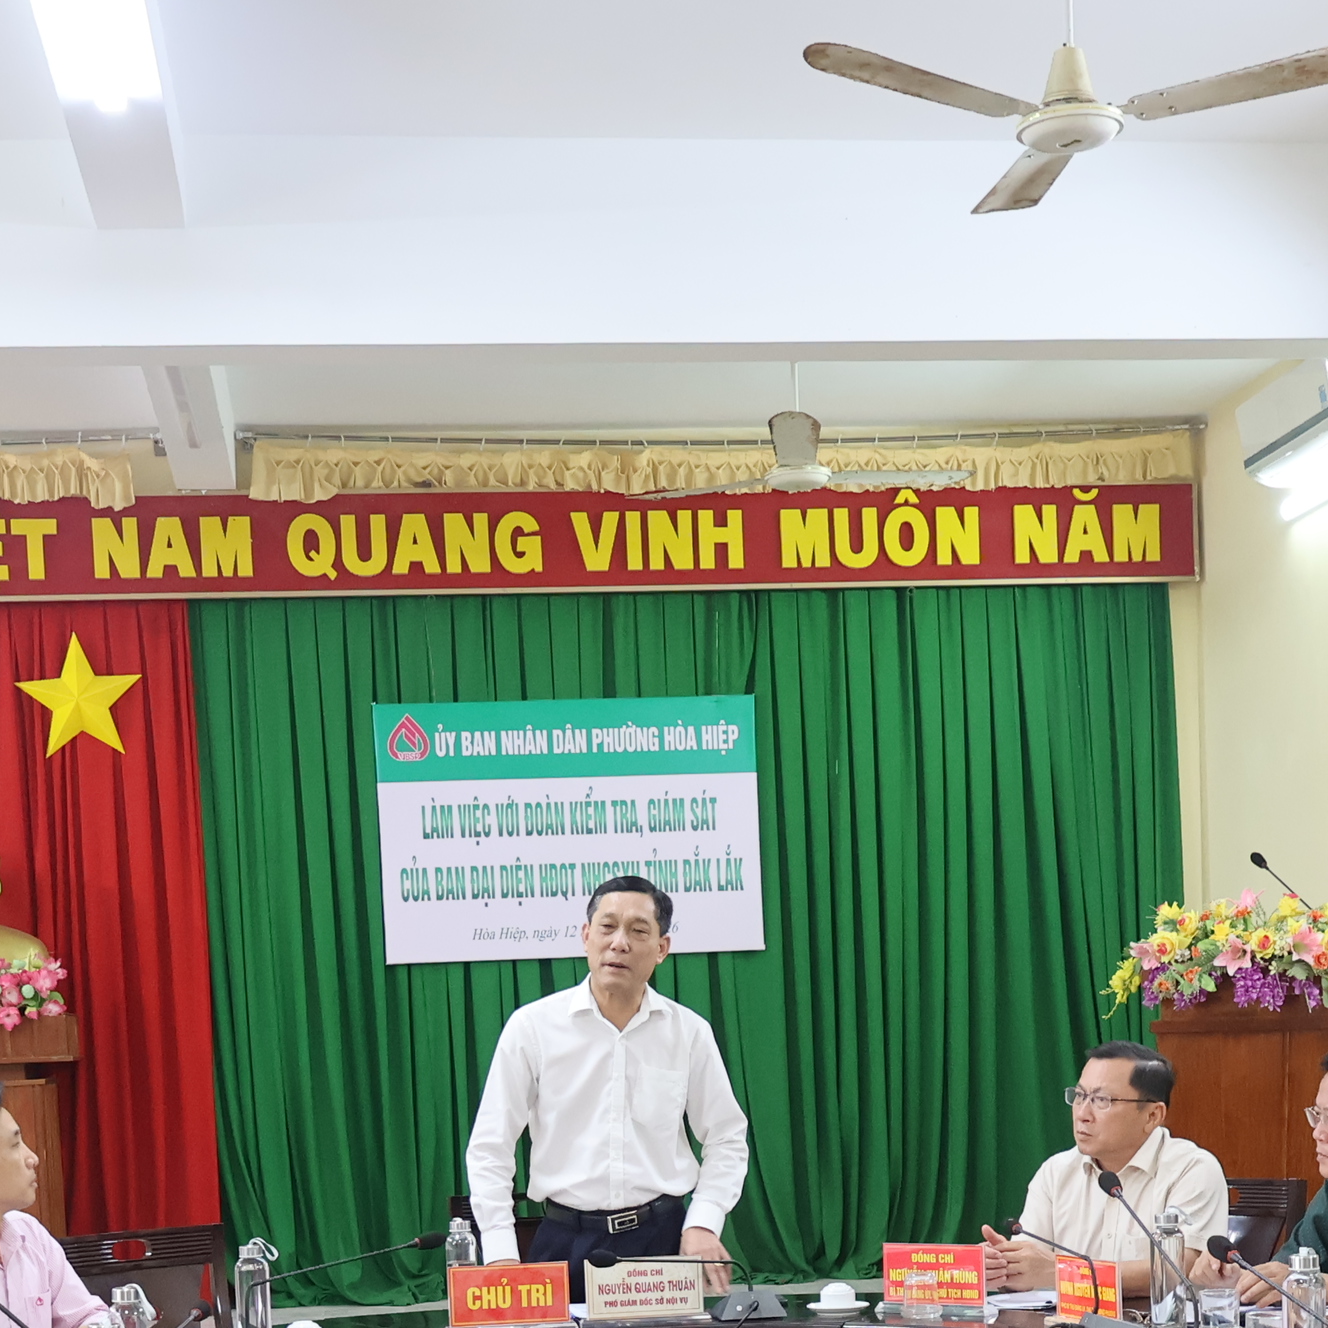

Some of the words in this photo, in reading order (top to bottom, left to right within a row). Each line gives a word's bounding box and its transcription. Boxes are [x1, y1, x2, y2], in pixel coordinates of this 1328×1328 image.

[91, 515, 254, 580] NAM
[286, 510, 544, 579] QUANG
[570, 508, 745, 573] VINH
[779, 490, 982, 569] MUÔN
[1014, 488, 1162, 565] NĂM
[435, 724, 456, 757] ỦY
[461, 731, 497, 756] BAN
[501, 725, 548, 755] NHÂN
[553, 724, 587, 754] DÂN
[592, 722, 659, 752] PHƯỜNG
[664, 720, 698, 751] HÒA
[702, 720, 740, 756] HIỆP
[421, 798, 454, 839] LÀM
[458, 796, 491, 845] VIỆC
[496, 795, 520, 837] VỚI
[525, 793, 566, 836] ĐOÀN
[570, 786, 607, 834] KIỂM
[611, 800, 643, 837] TRA,
[648, 792, 685, 832] GIÁM
[690, 790, 717, 831] SÁT
[400, 856, 431, 902] CỦA
[435, 866, 466, 900] BAN
[470, 865, 494, 906] ĐẠI
[500, 857, 534, 906] DIỆN
[540, 862, 576, 901] HĐQT
[645, 848, 678, 893] TỈNH
[683, 845, 712, 892] ĐẮK
[716, 844, 744, 891] LẮK
[472, 927, 498, 941] Hòa
[500, 925, 529, 943] Hiệp,
[532, 926, 560, 942] ngày
[564, 925, 578, 938] 12
[466, 1278, 512, 1310] CHỦ
[518, 1280, 553, 1307] TRÌ
[634, 1281, 666, 1294] QUANG
